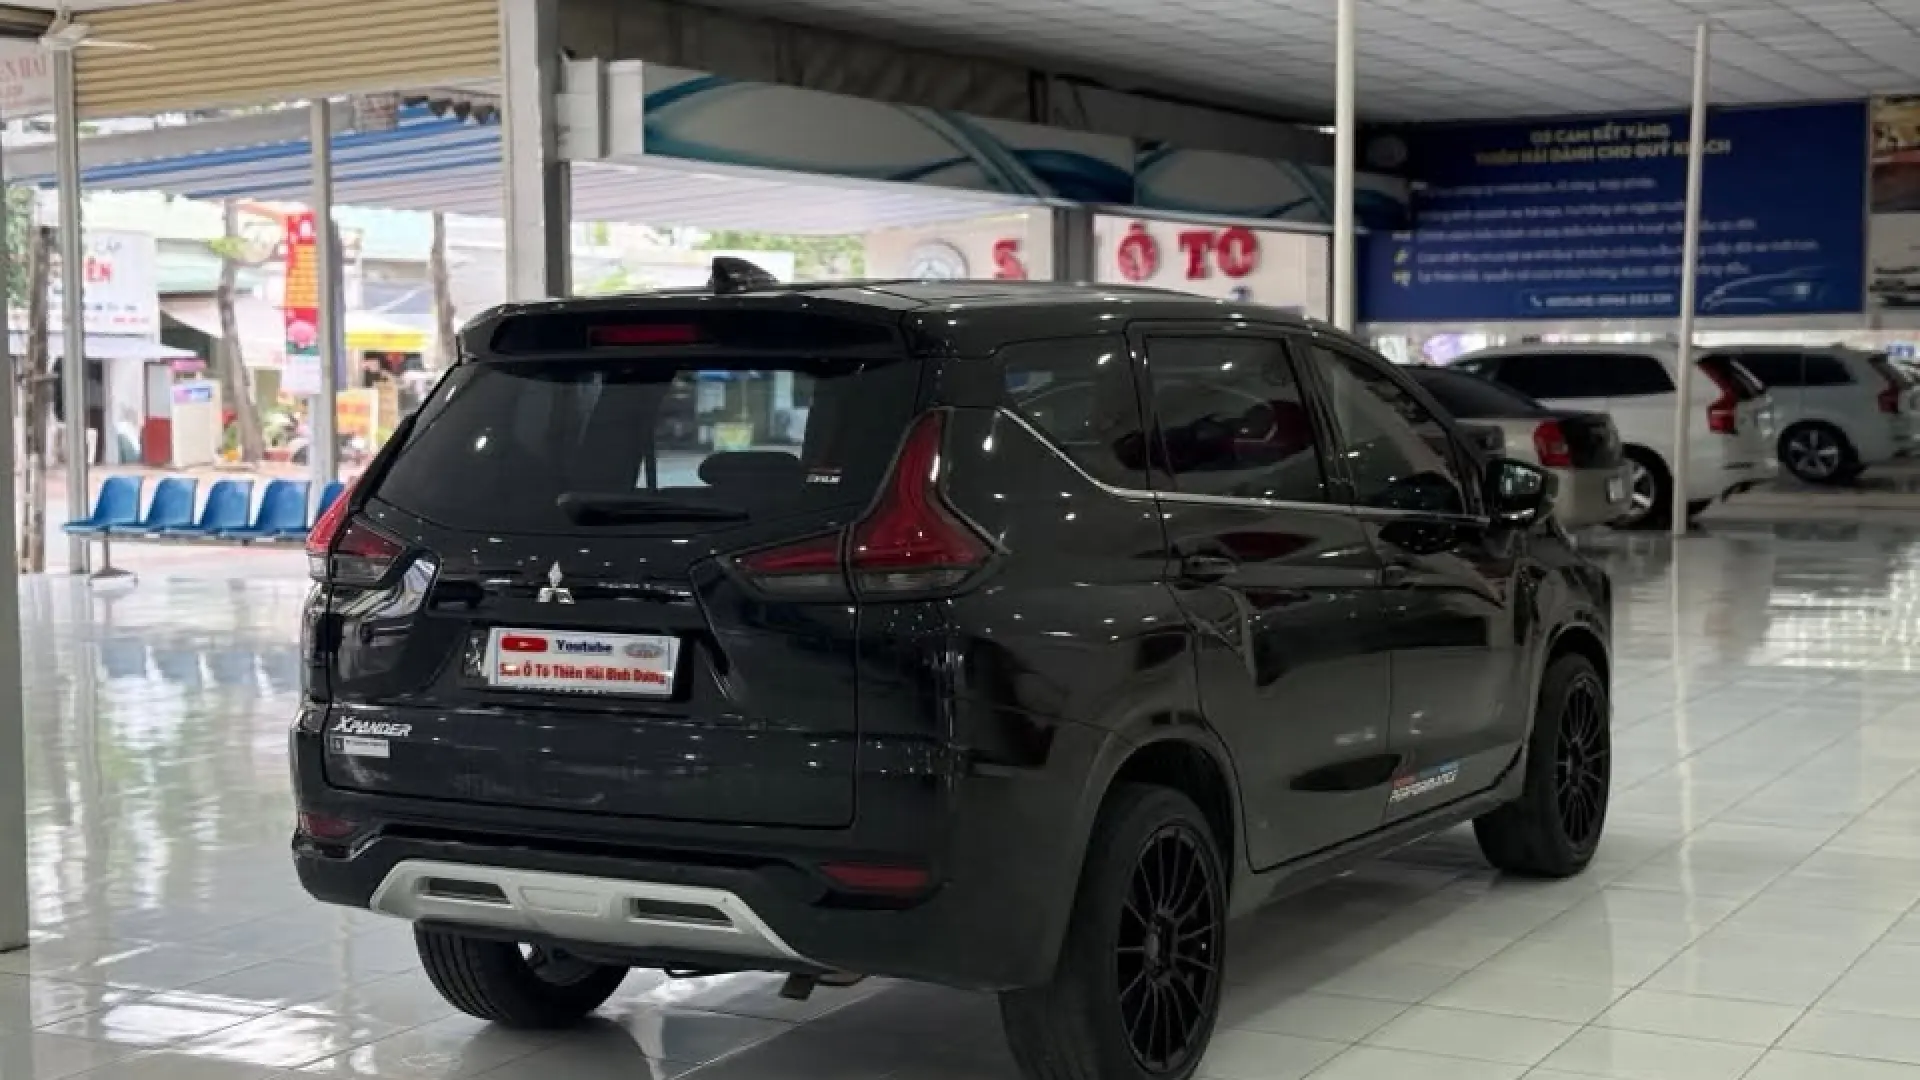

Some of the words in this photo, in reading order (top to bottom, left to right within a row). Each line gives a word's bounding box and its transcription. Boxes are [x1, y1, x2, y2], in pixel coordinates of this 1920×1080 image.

[1117, 221, 1158, 281] Ô
[556, 639, 613, 654] Youtube
[331, 715, 412, 737] XPANDER
